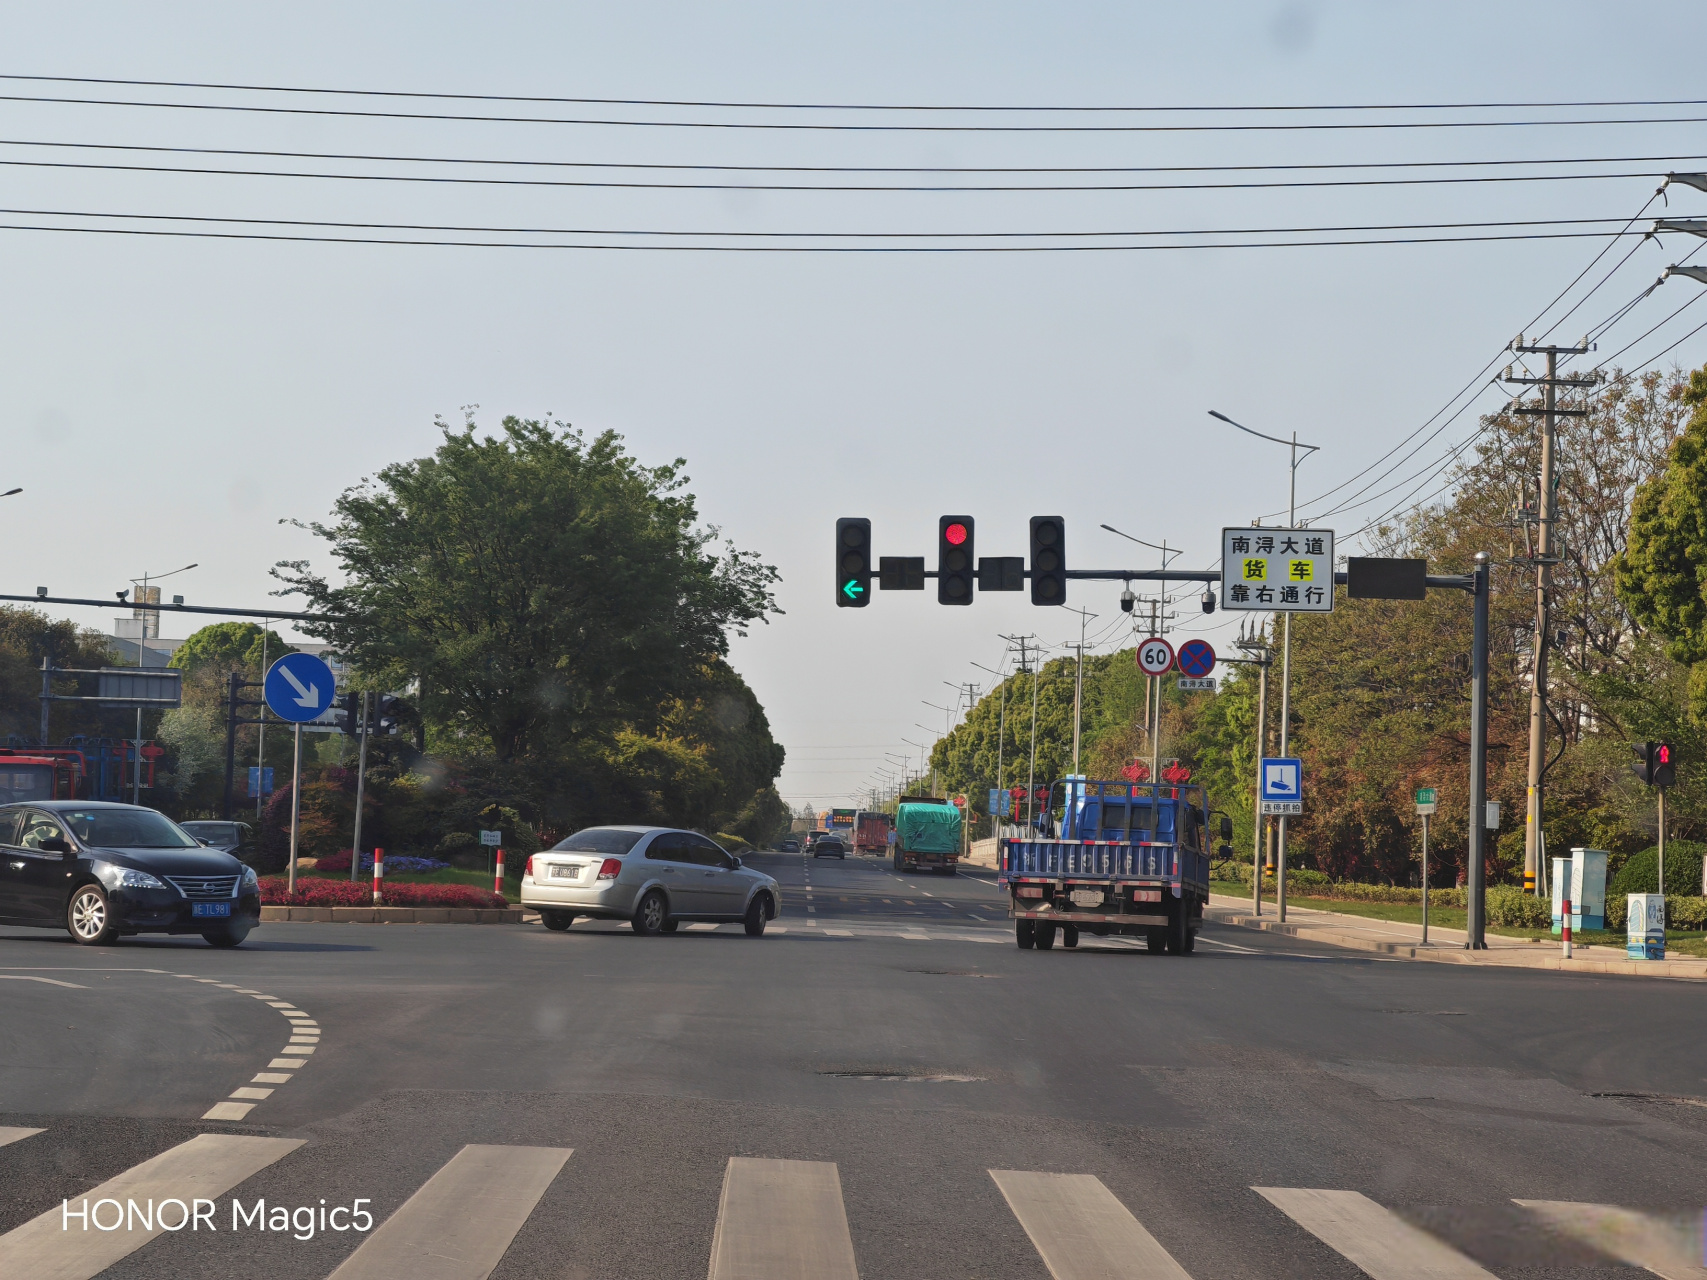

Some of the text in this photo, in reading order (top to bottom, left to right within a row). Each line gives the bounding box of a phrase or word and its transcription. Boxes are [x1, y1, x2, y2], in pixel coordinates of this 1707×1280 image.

[1231, 535, 1325, 556] 南浔大道
[1244, 559, 1312, 580] 货车
[1230, 583, 1325, 605] 靠右通行
[1145, 648, 1167, 665] 60
[1263, 803, 1301, 813] 违停抓拍
